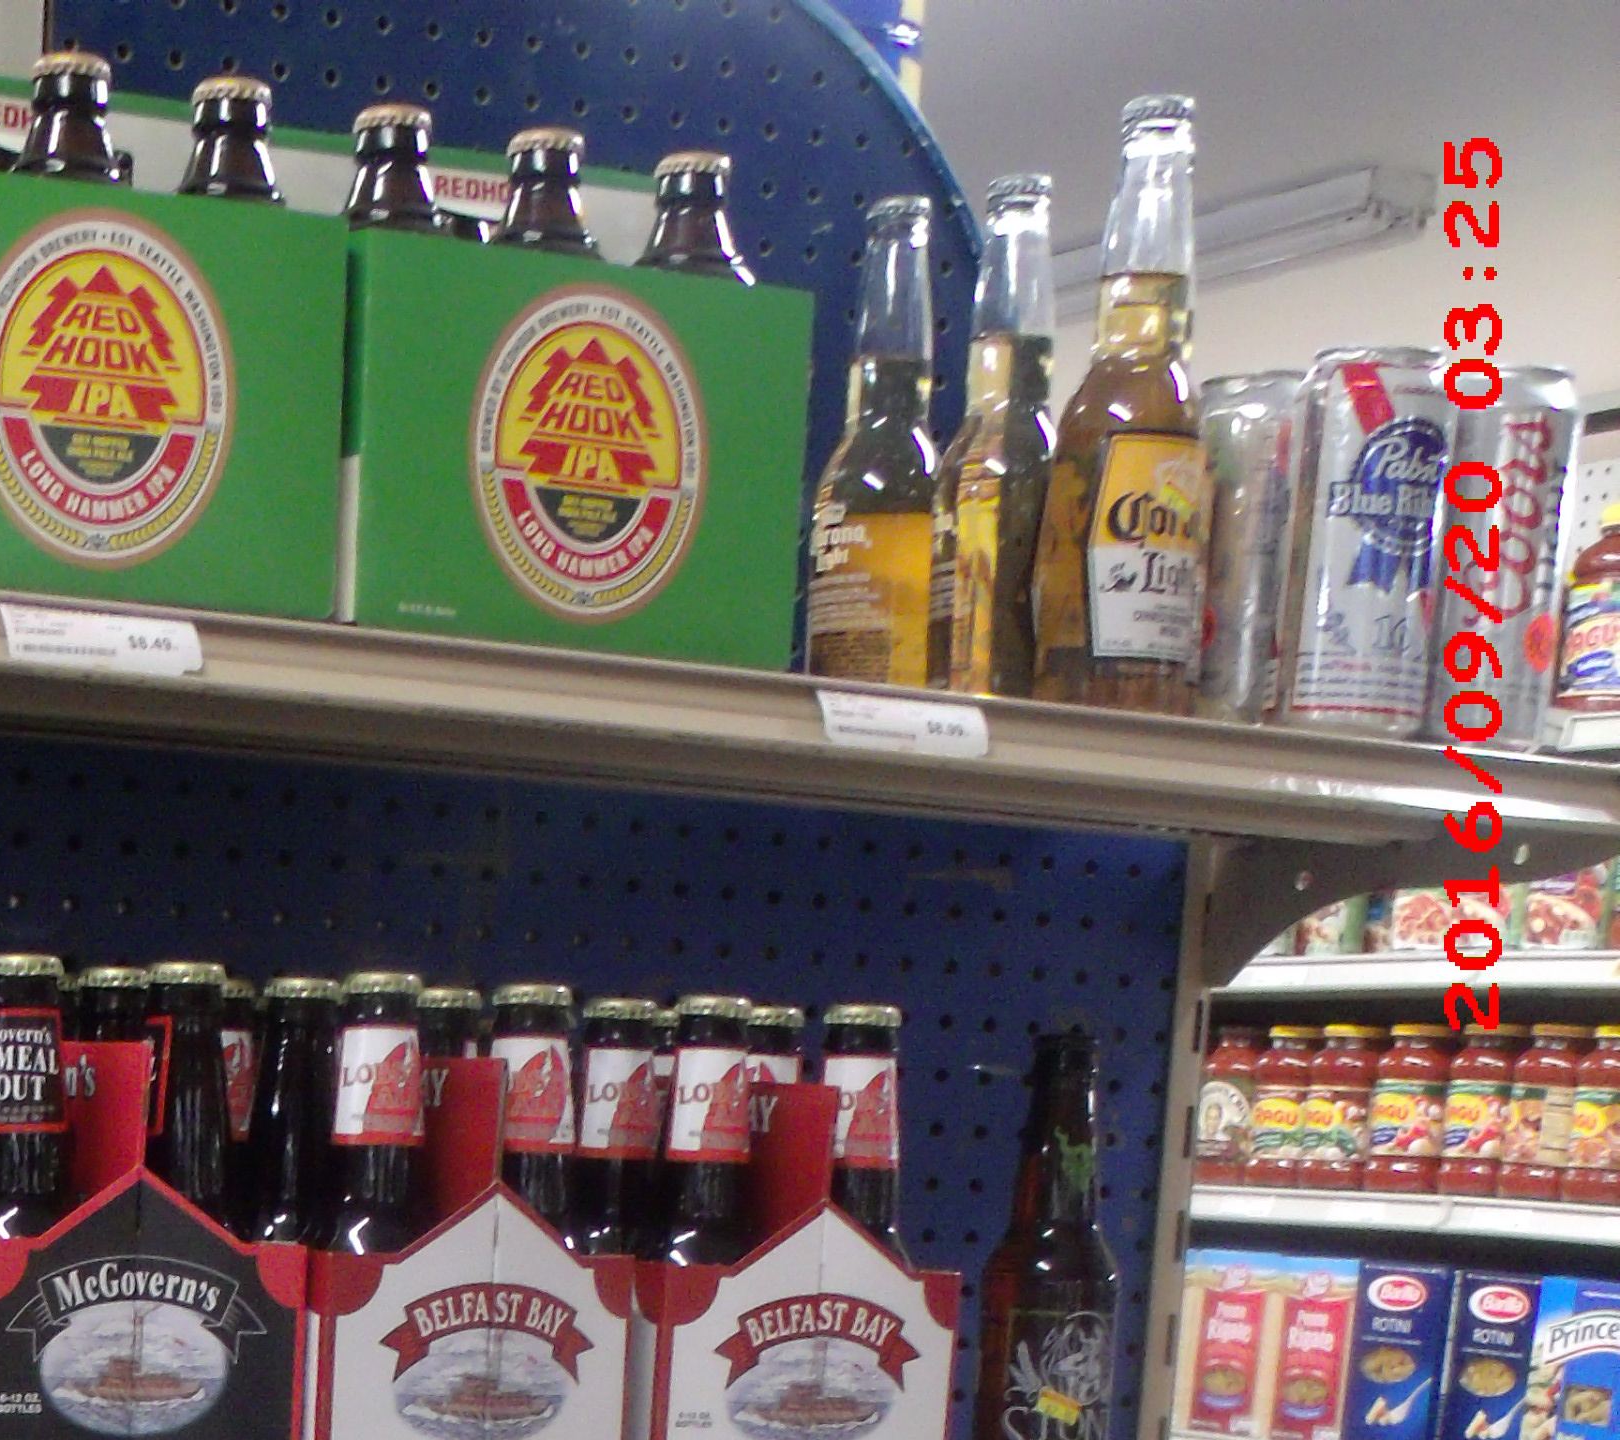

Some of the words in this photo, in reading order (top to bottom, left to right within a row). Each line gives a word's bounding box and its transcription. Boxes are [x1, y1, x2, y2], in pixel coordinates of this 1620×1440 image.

[61, 302, 143, 334] RED
[43, 334, 160, 375] HOOK
[69, 379, 137, 420] IPA
[557, 371, 627, 403] RED
[538, 401, 642, 441] HOOK
[561, 444, 622, 483] IPA
[53, 1262, 221, 1313] McGovern's
[413, 1289, 521, 1338] BELFAST
[527, 1299, 569, 1339] BAY
[745, 1299, 849, 1349] BELFAST
[853, 1309, 896, 1347] BAY
